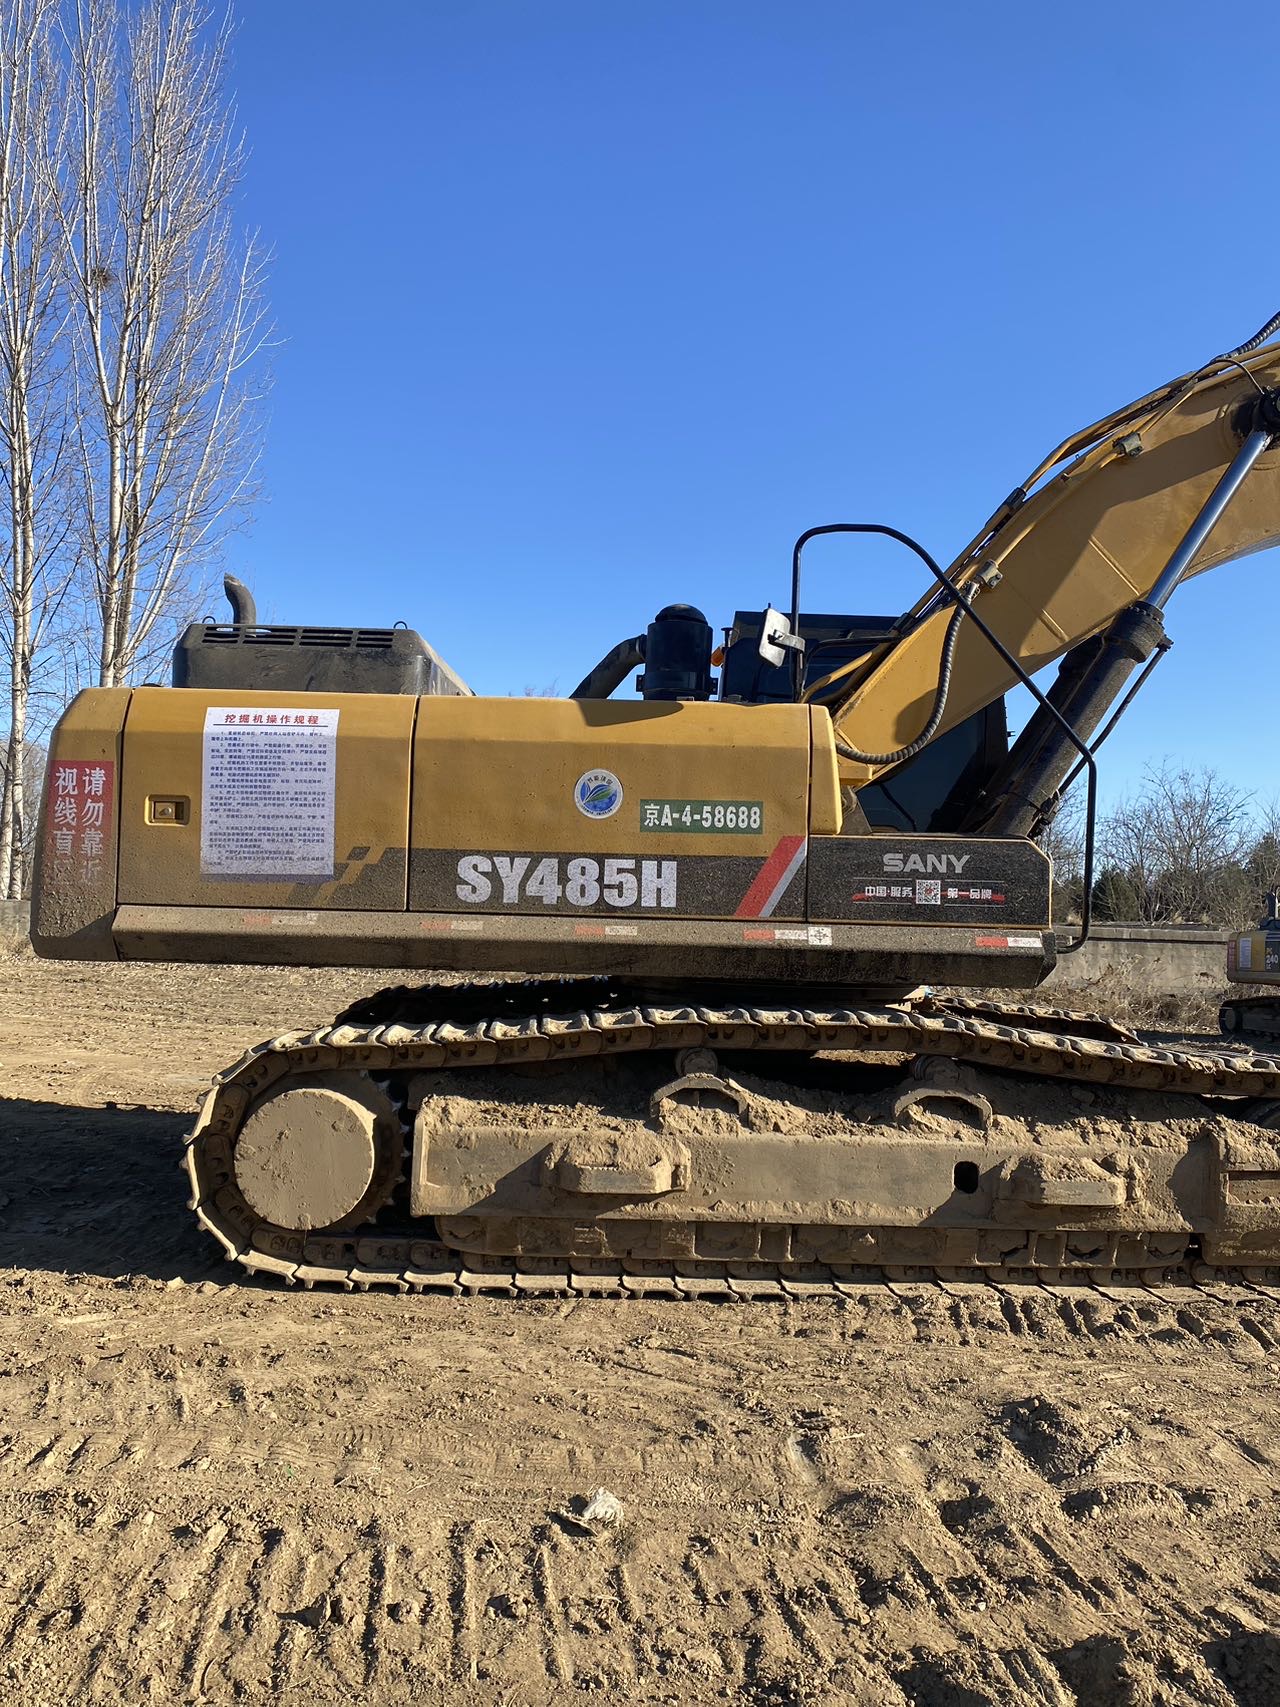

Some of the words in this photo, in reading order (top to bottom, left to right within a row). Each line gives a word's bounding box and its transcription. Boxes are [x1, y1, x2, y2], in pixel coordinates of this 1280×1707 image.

[224, 713, 320, 725] 挖掘机操作规程
[54, 766, 78, 881] 视线盲
[643, 803, 760, 829] 京A-4-58688
[883, 853, 970, 873] SANY
[456, 855, 678, 908] SY485H
[947, 887, 993, 899] 第一品牌
